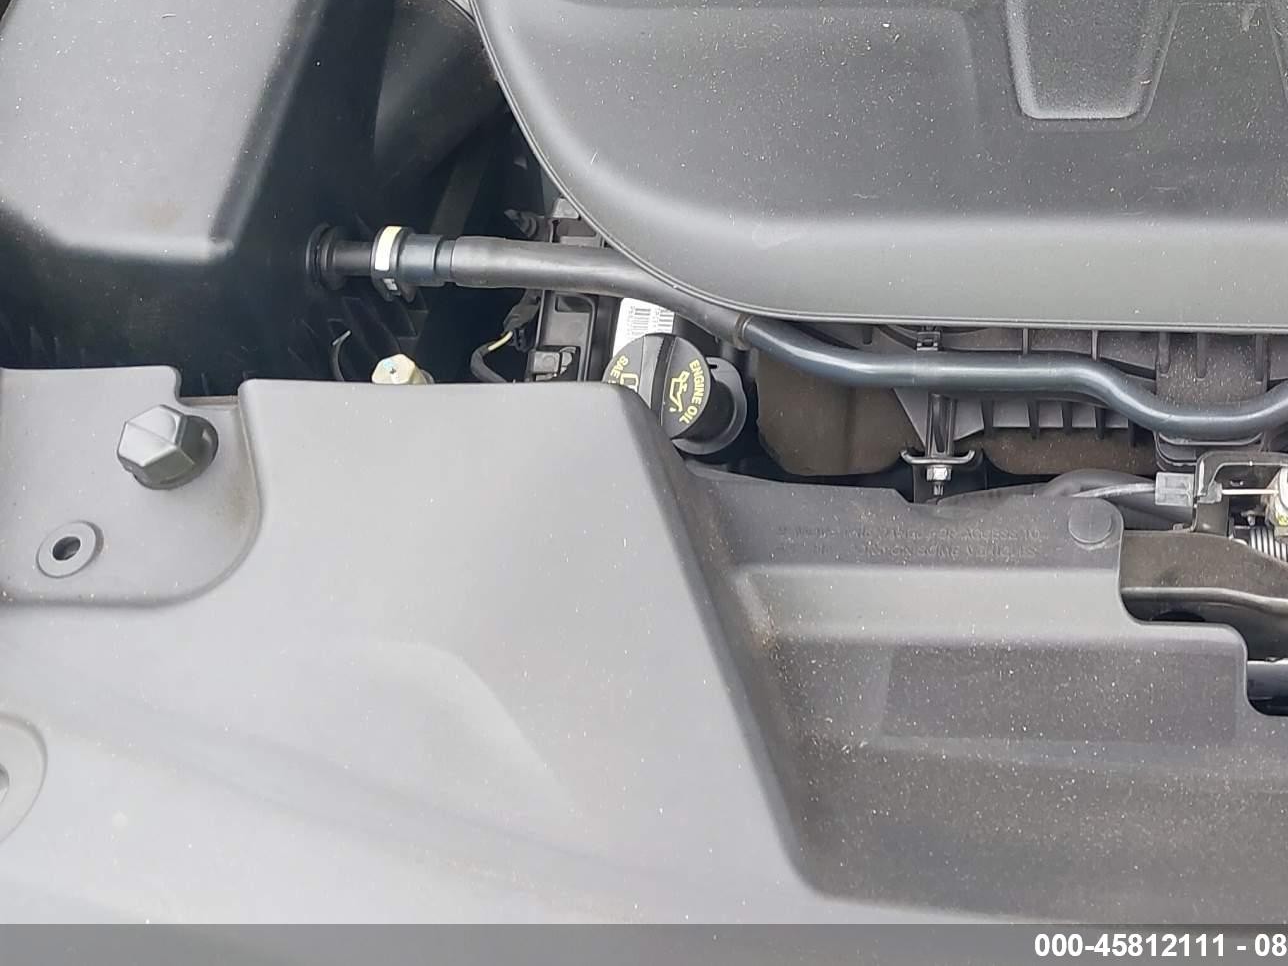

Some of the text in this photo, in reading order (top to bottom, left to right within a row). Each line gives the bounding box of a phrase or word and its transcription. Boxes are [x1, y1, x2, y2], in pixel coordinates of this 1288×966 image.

[609, 355, 629, 379] SAE
[679, 359, 706, 424] ENGINE OIL
